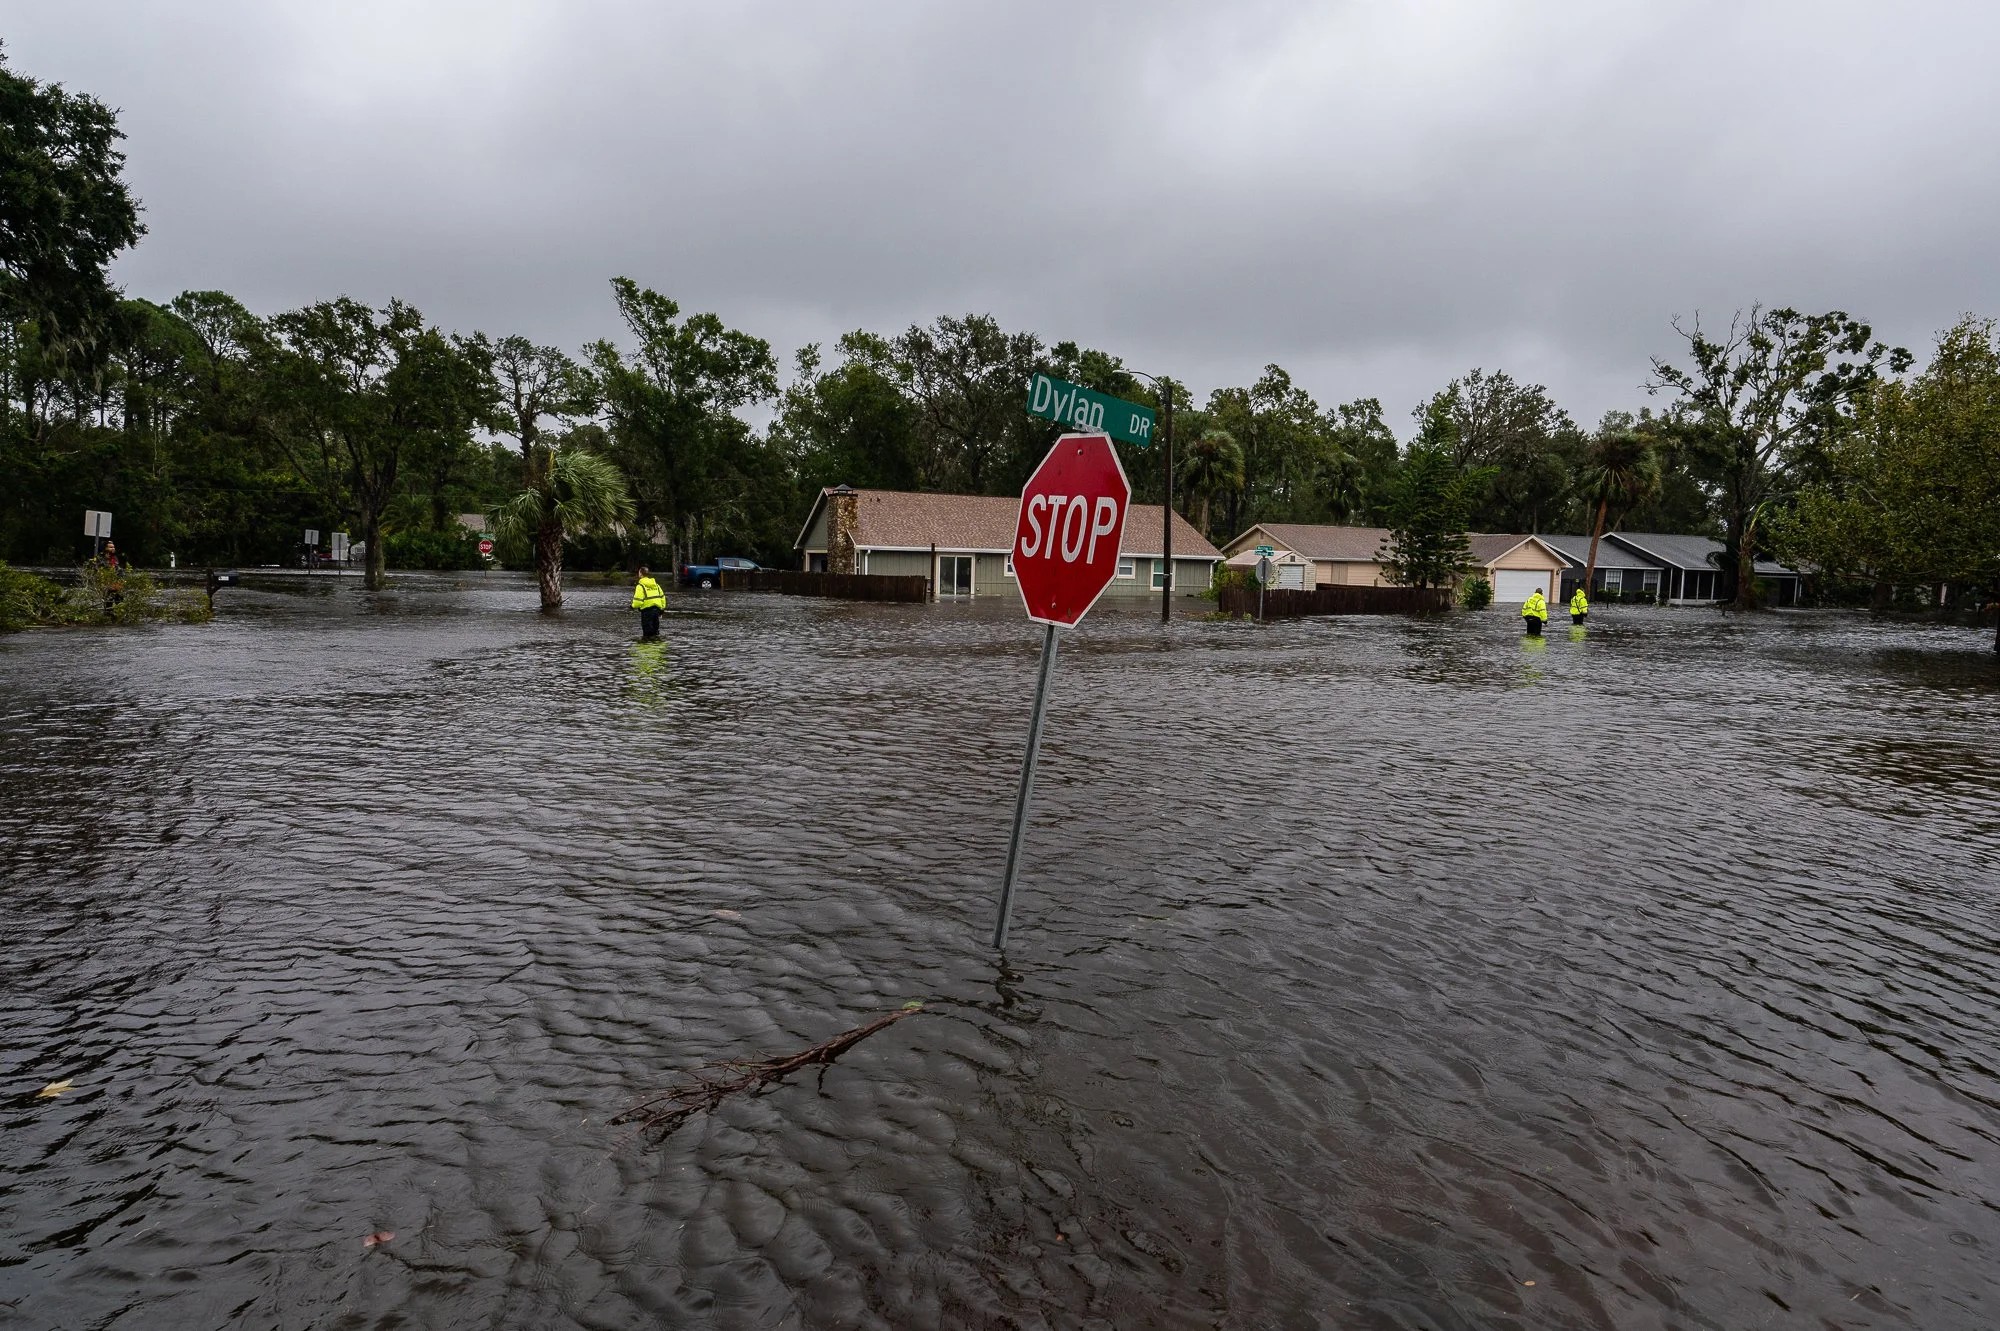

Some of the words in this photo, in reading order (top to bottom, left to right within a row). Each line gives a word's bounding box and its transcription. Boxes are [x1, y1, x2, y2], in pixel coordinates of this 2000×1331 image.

[1032, 375, 1104, 429] Dylan
[1129, 413, 1150, 438] DR
[1021, 494, 1118, 564] STOP
